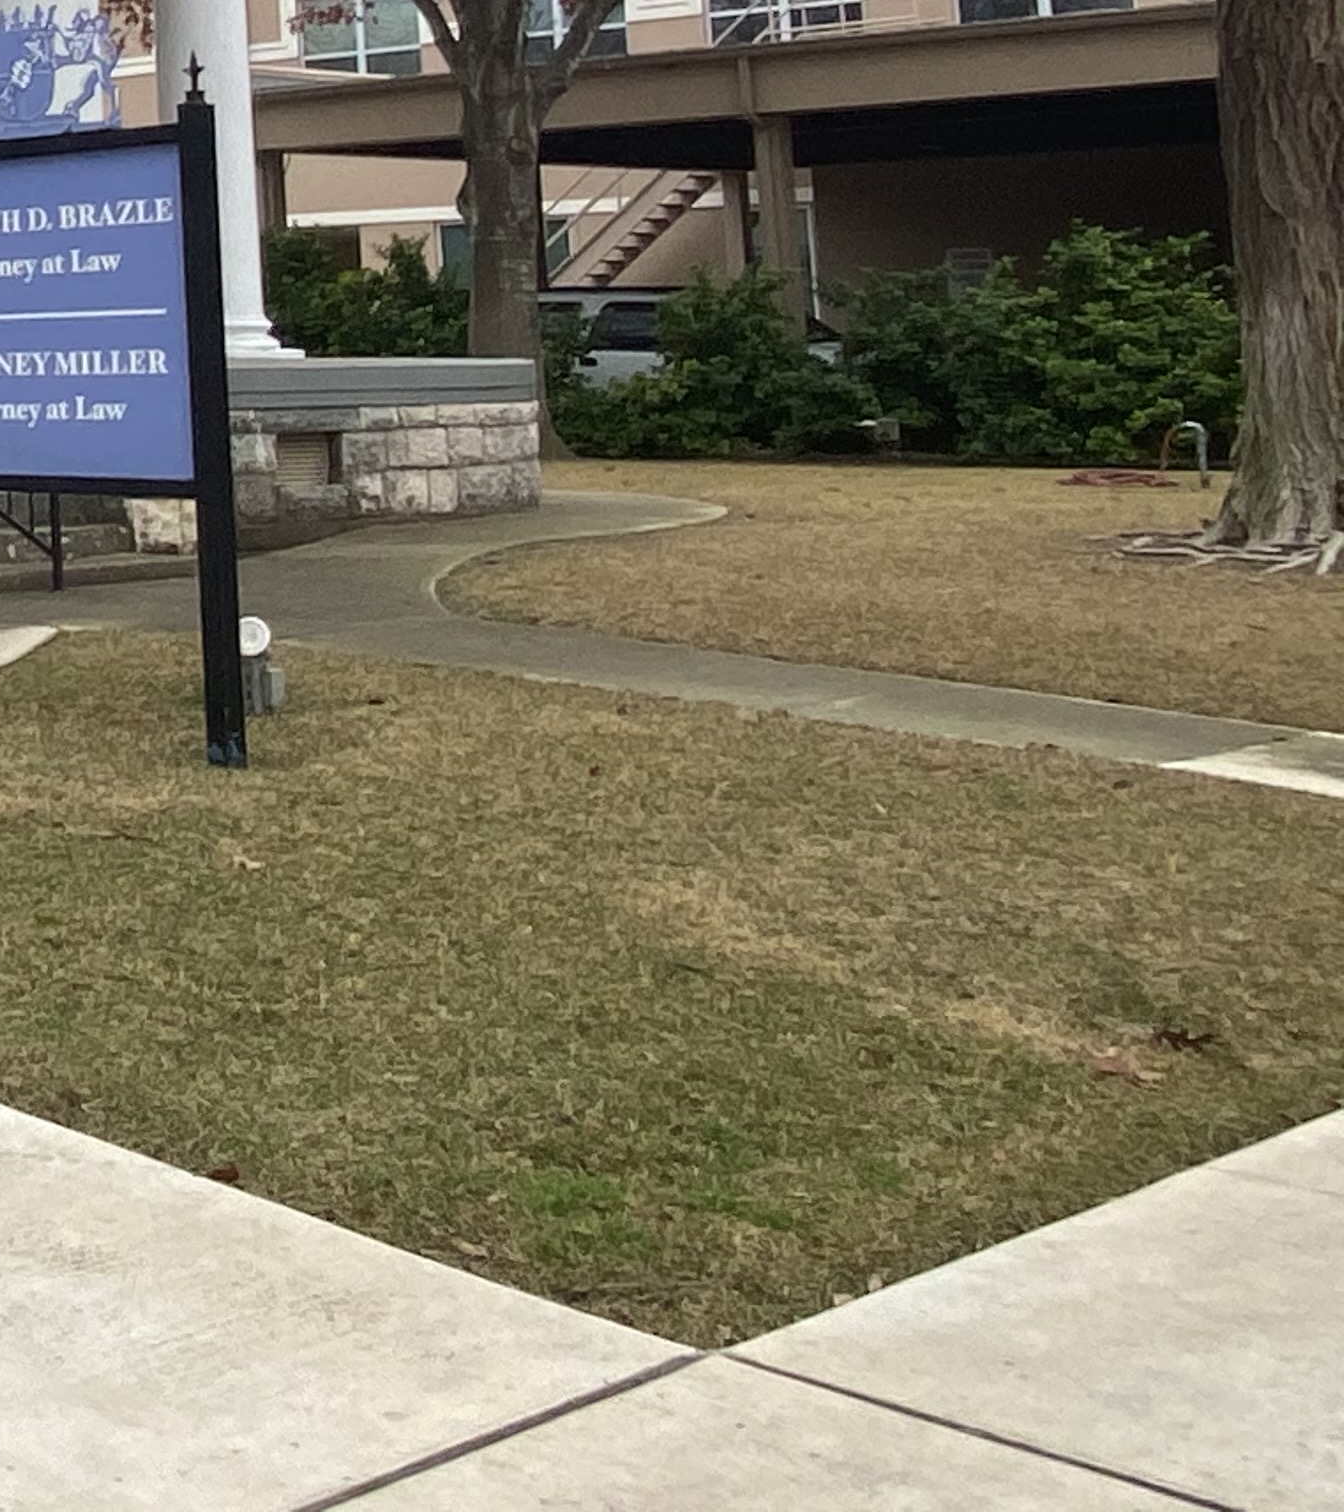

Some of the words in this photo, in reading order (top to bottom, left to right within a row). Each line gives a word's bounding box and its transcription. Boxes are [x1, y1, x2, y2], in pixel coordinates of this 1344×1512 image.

[26, 207, 53, 232] D.
[58, 197, 173, 230] BRAZLE
[41, 254, 65, 274] at
[69, 248, 122, 273] Law
[54, 348, 169, 376] MILLER
[45, 400, 70, 421] at
[75, 395, 128, 421] Law
